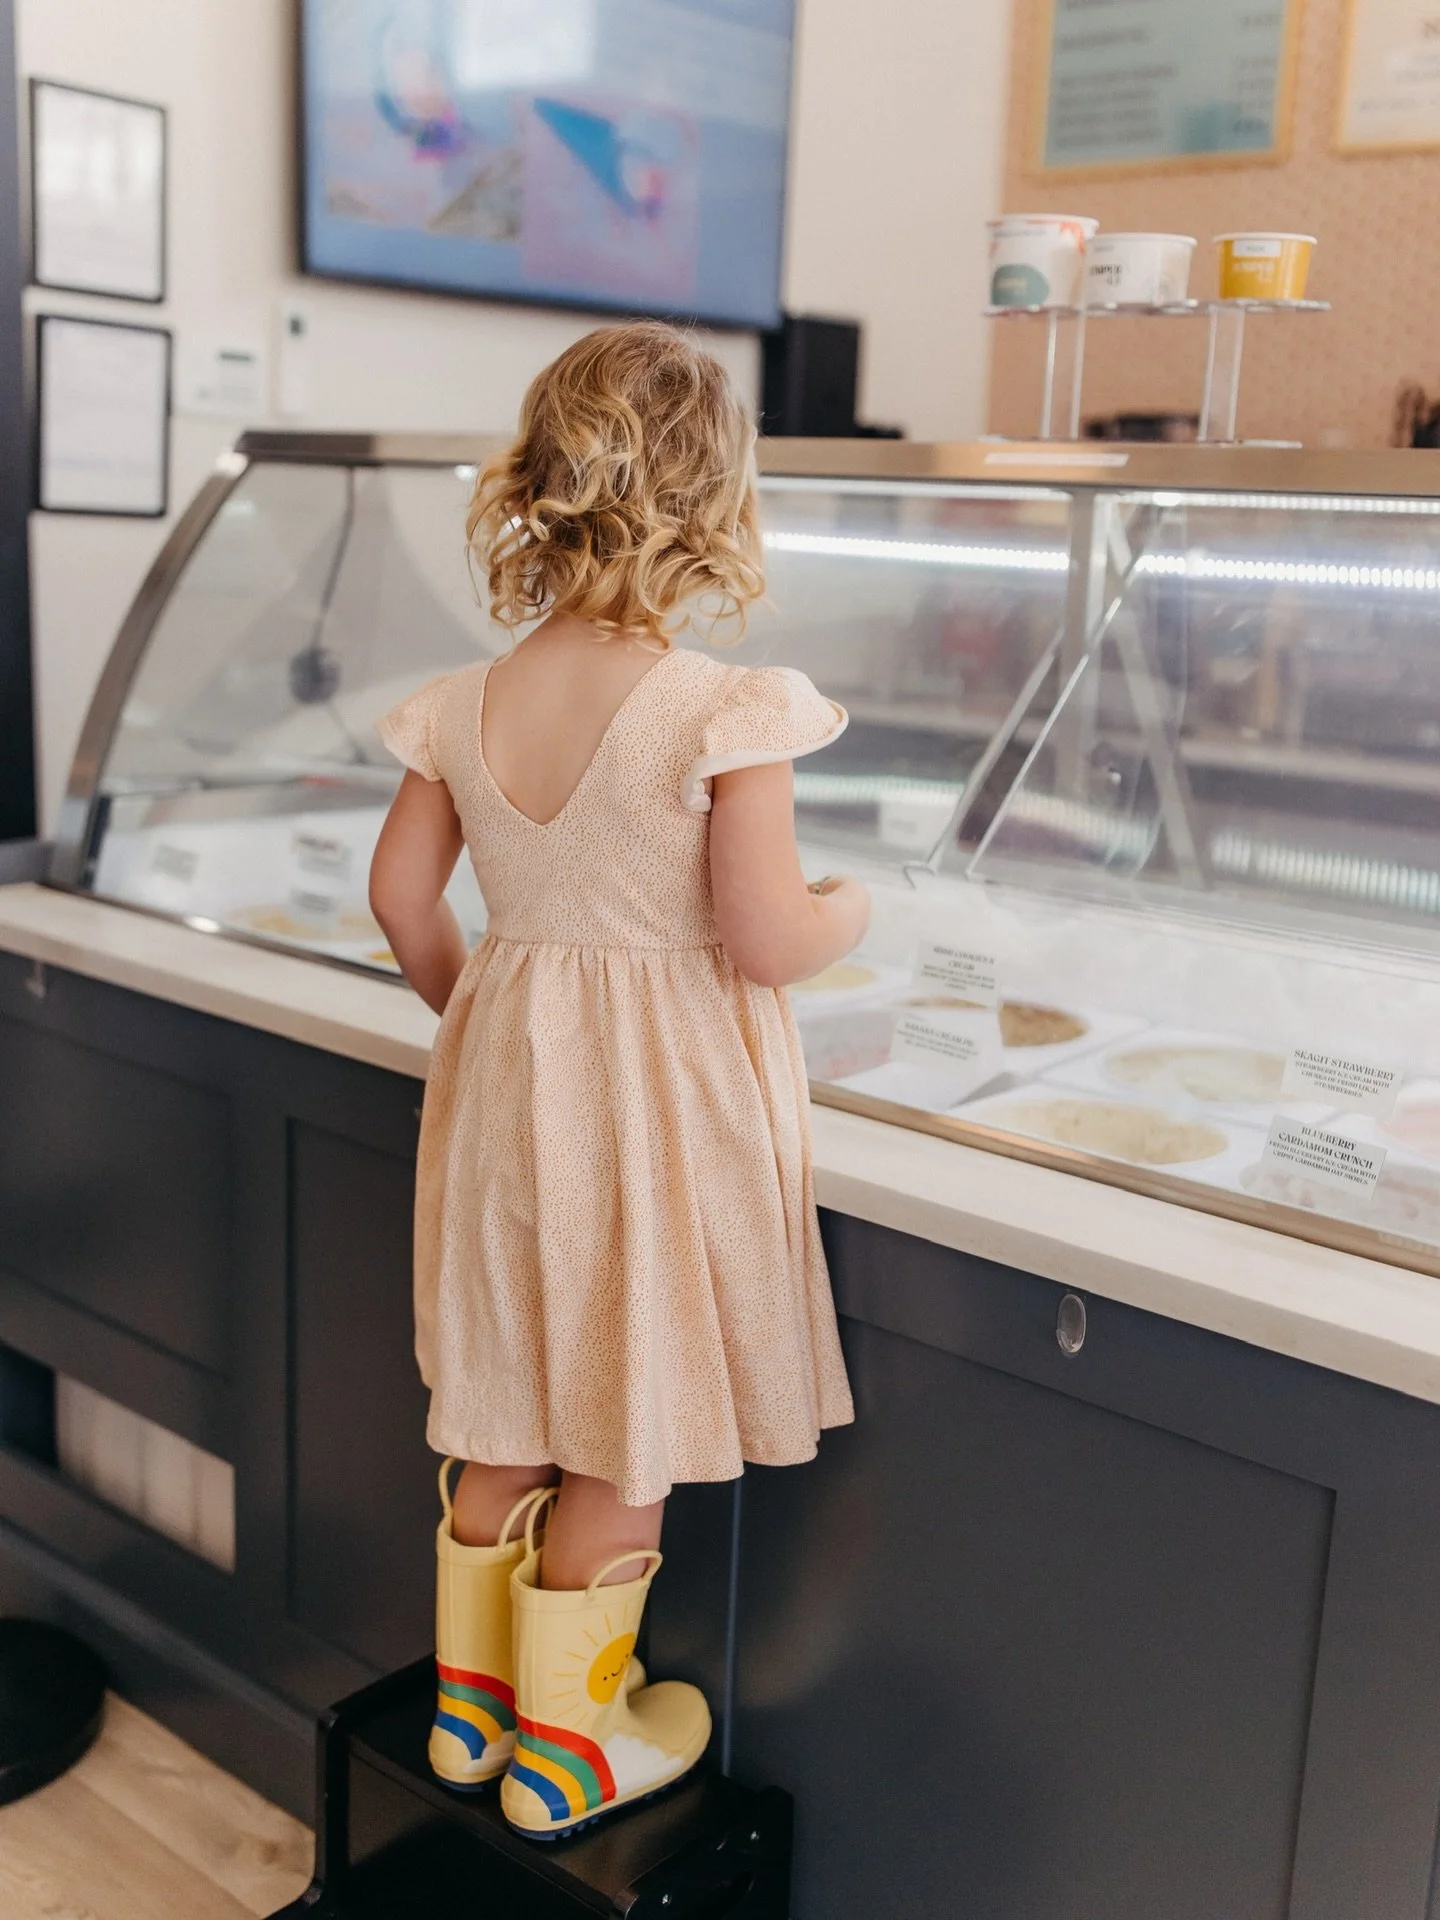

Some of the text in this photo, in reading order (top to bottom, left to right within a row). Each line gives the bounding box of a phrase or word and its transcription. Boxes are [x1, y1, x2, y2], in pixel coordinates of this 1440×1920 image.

[1294, 1049, 1395, 1081] SKAGIT STRAWBERRY
[1278, 1131, 1374, 1170] CARDAMOM CRUNCH
[1301, 1126, 1357, 1151] BLUEBERRY
